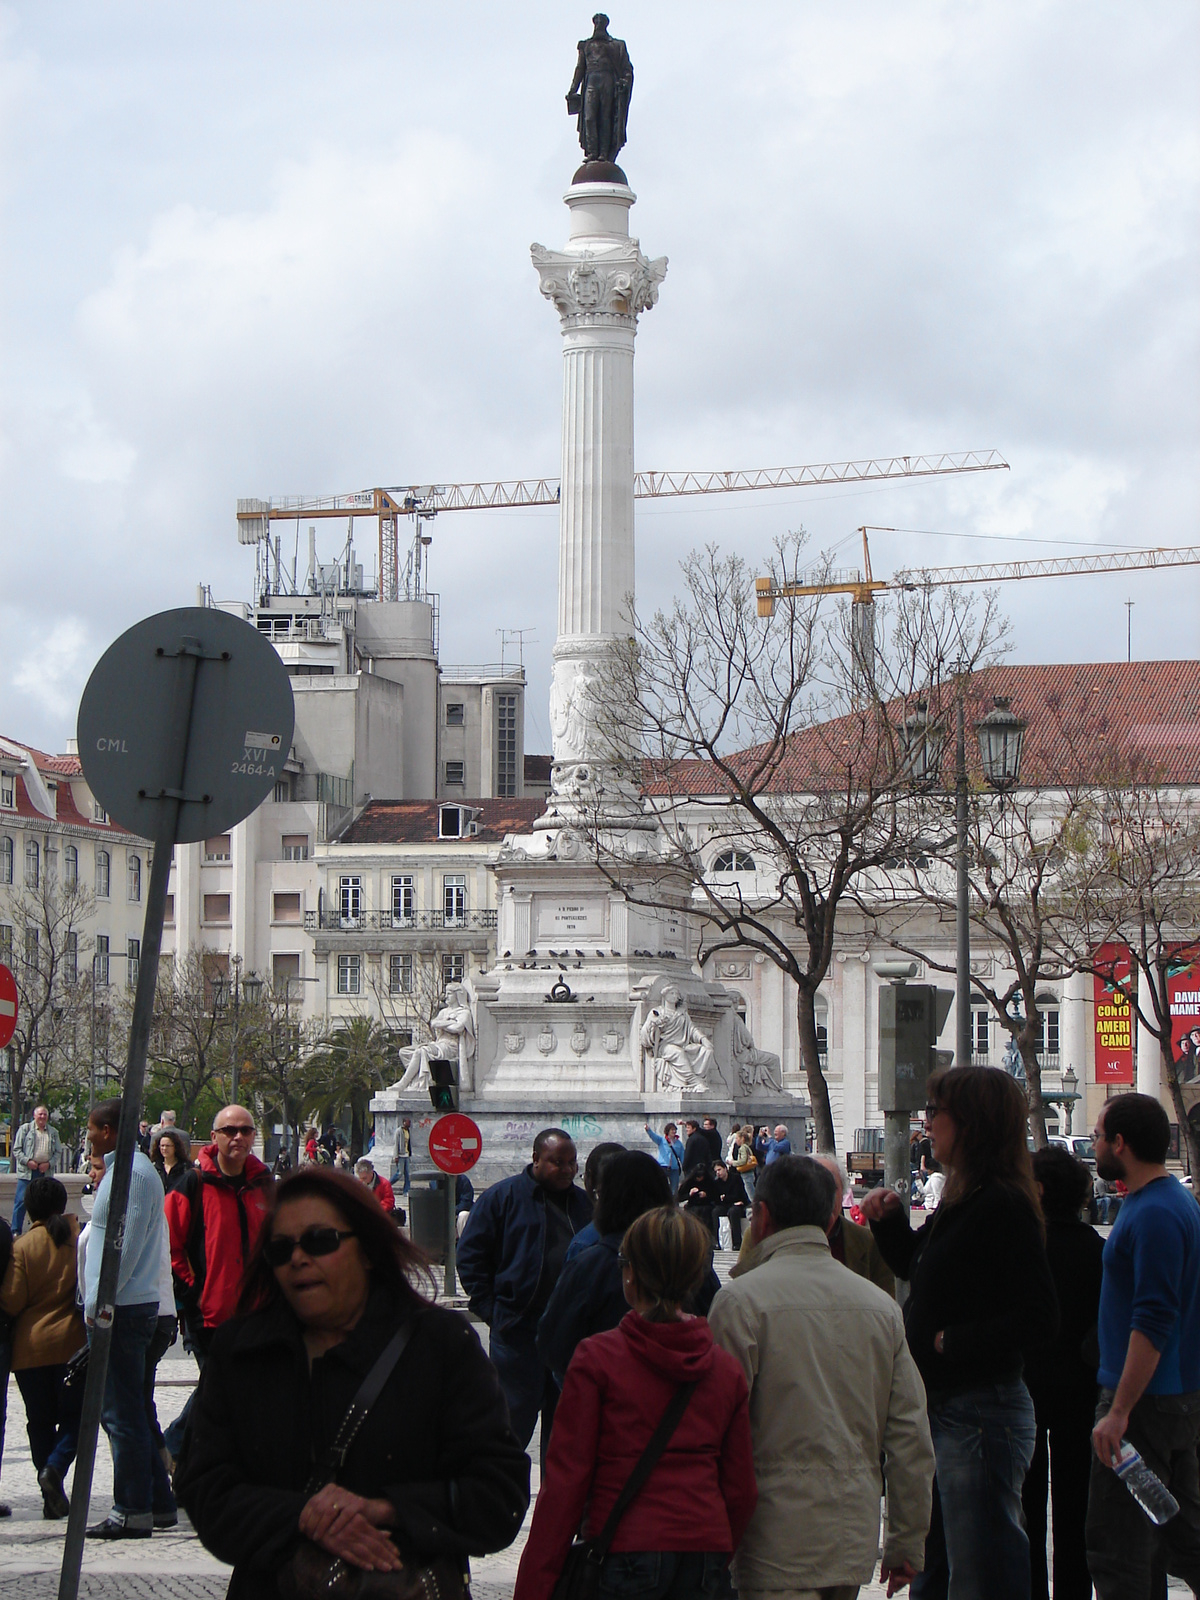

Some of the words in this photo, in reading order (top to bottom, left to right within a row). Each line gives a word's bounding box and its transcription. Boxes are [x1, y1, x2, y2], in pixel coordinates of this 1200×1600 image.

[96, 738, 129, 753] CML
[242, 748, 267, 762] XVI
[231, 762, 275, 777] 2464-A
[1174, 992, 1200, 1002] DAVI
[1097, 1005, 1130, 1016] CONTO
[1096, 1021, 1130, 1032] AMERI
[1100, 1034, 1131, 1047] CANO
